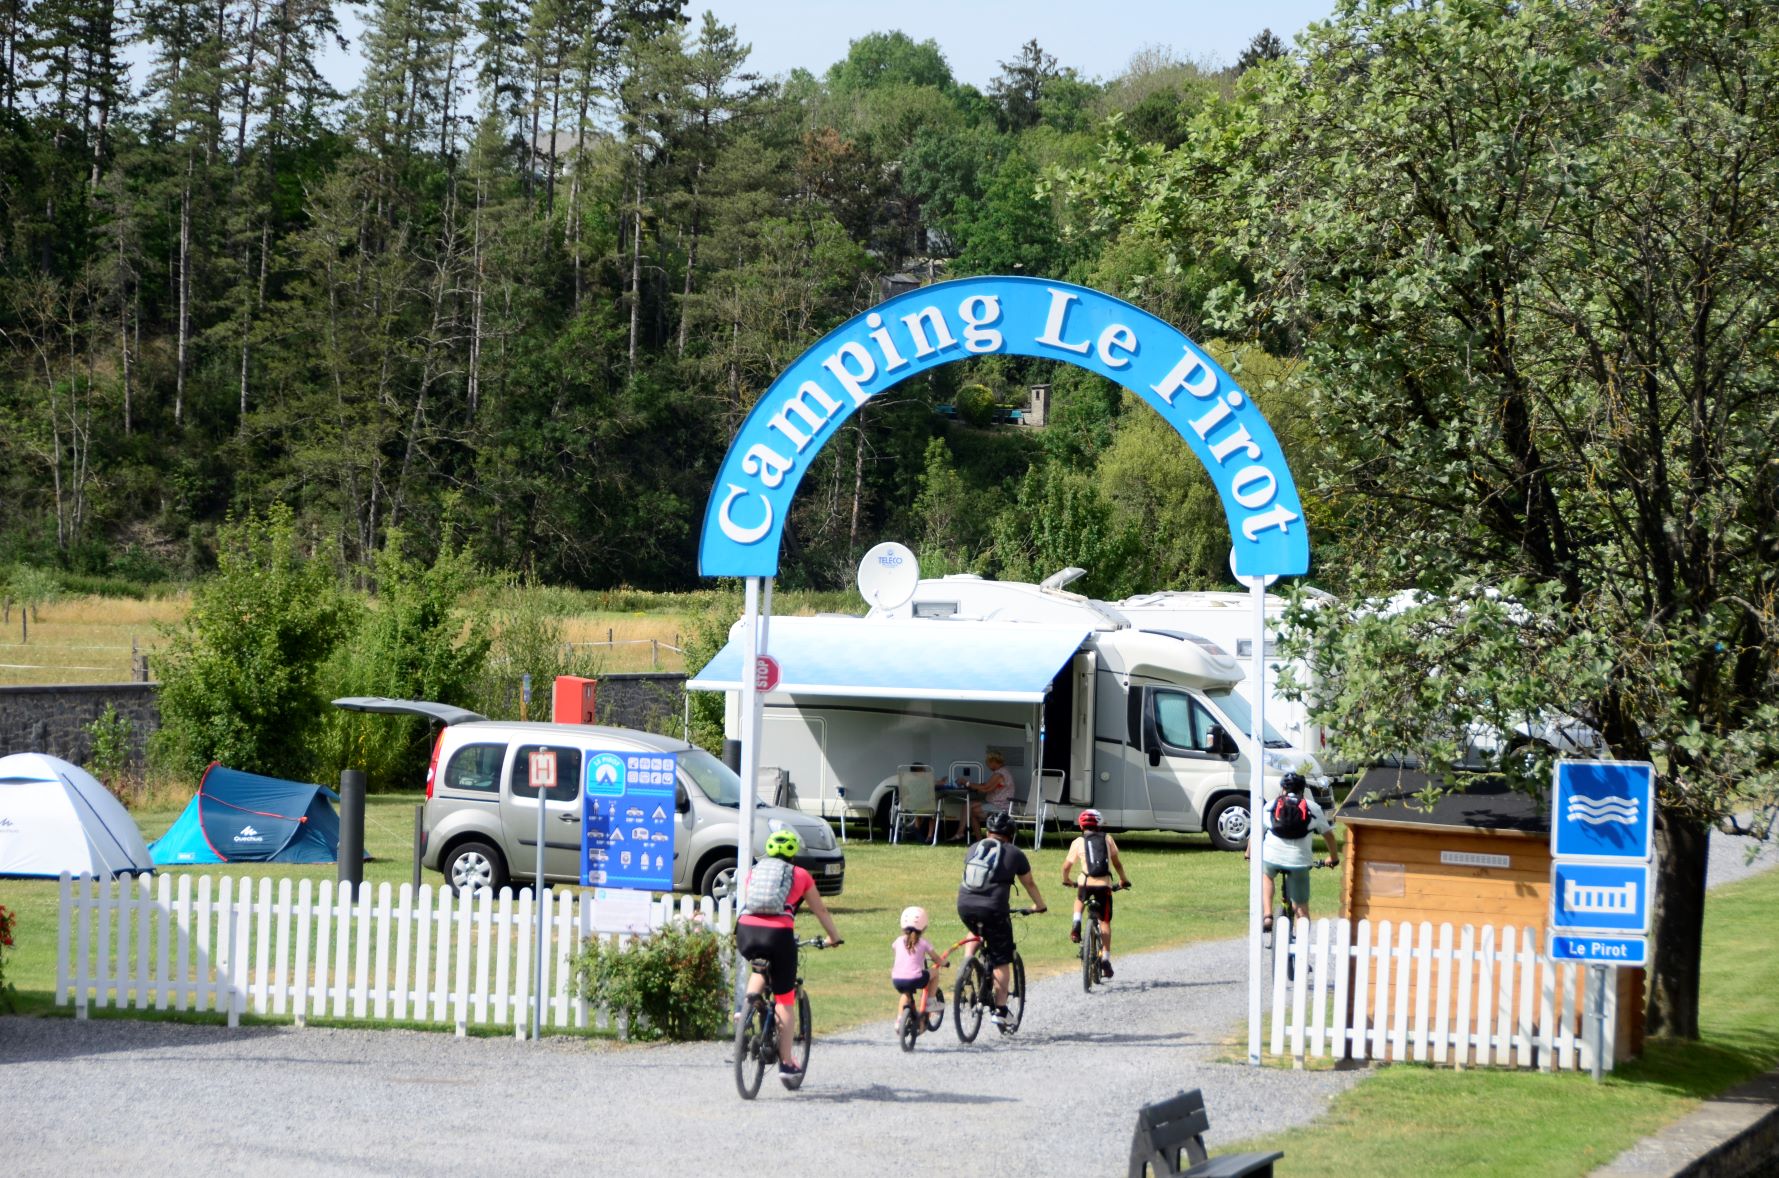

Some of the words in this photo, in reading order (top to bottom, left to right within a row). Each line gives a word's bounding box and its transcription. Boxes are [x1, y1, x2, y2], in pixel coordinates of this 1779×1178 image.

[719, 295, 1003, 543] Camping
[1035, 288, 1137, 367] Le
[1151, 346, 1298, 541] Pirot
[878, 556, 903, 564] TELECO
[757, 660, 769, 688] STOP
[535, 759, 550, 780] H
[233, 835, 263, 843] Quechua
[1569, 941, 1585, 955] Le
[1591, 942, 1627, 957] Pirot
